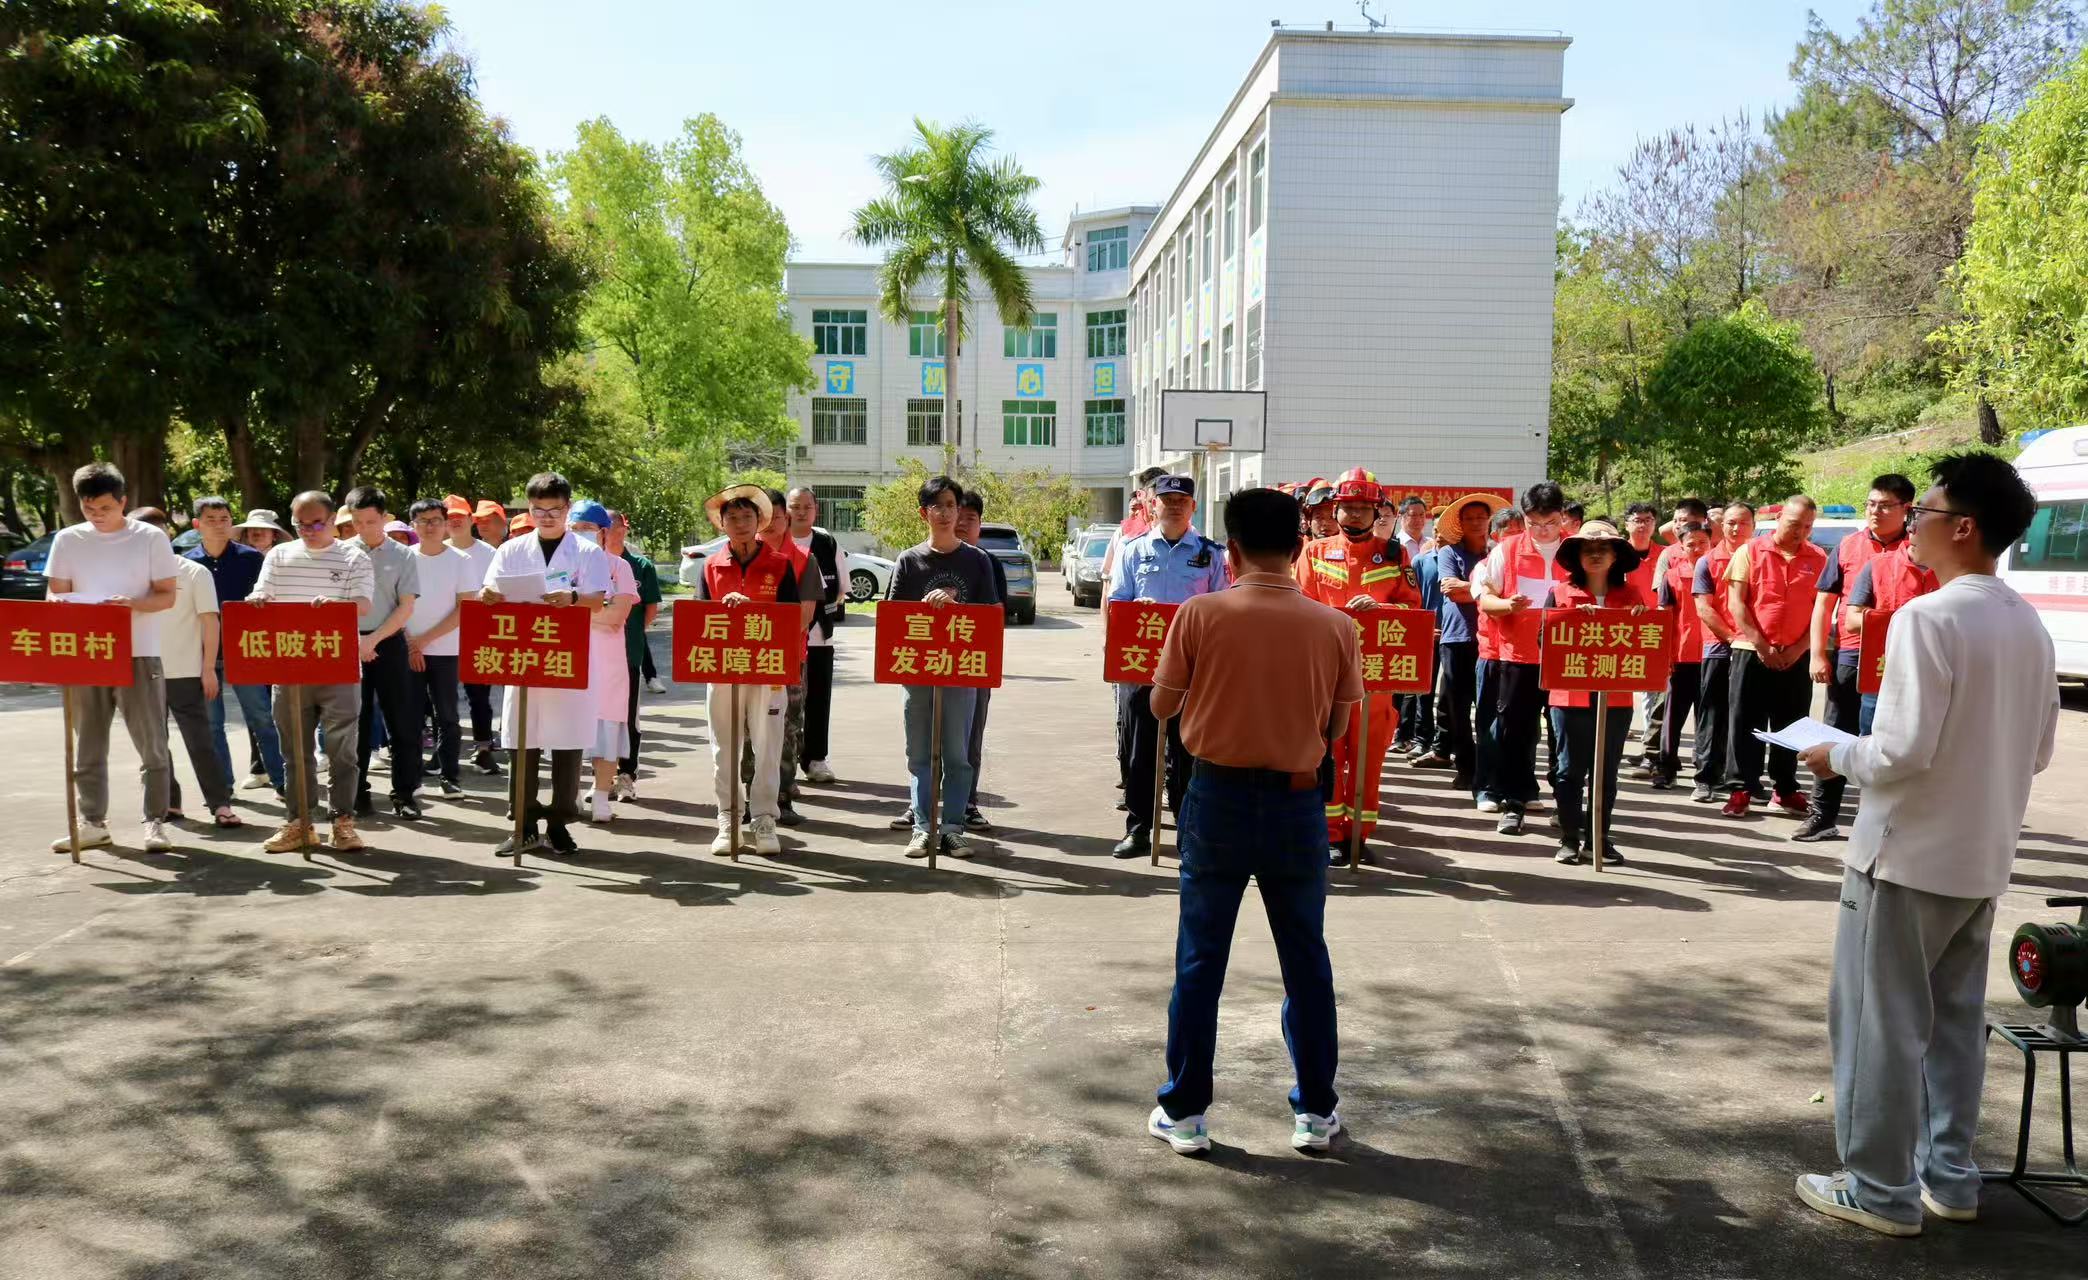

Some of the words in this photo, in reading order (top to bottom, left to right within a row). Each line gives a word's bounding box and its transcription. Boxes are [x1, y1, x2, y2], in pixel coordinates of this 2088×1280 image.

[490, 614, 562, 644] 卫生
[702, 613, 773, 642] 后勤
[905, 613, 976, 643] 宣传
[1550, 621, 1663, 650] 山洪灾害
[11, 628, 116, 661] 车田村
[239, 629, 343, 659] 低陂村
[474, 646, 576, 679] 救护组
[688, 645, 786, 676] 保障组
[890, 646, 989, 678] 发动组
[1562, 653, 1648, 681] 监测组
